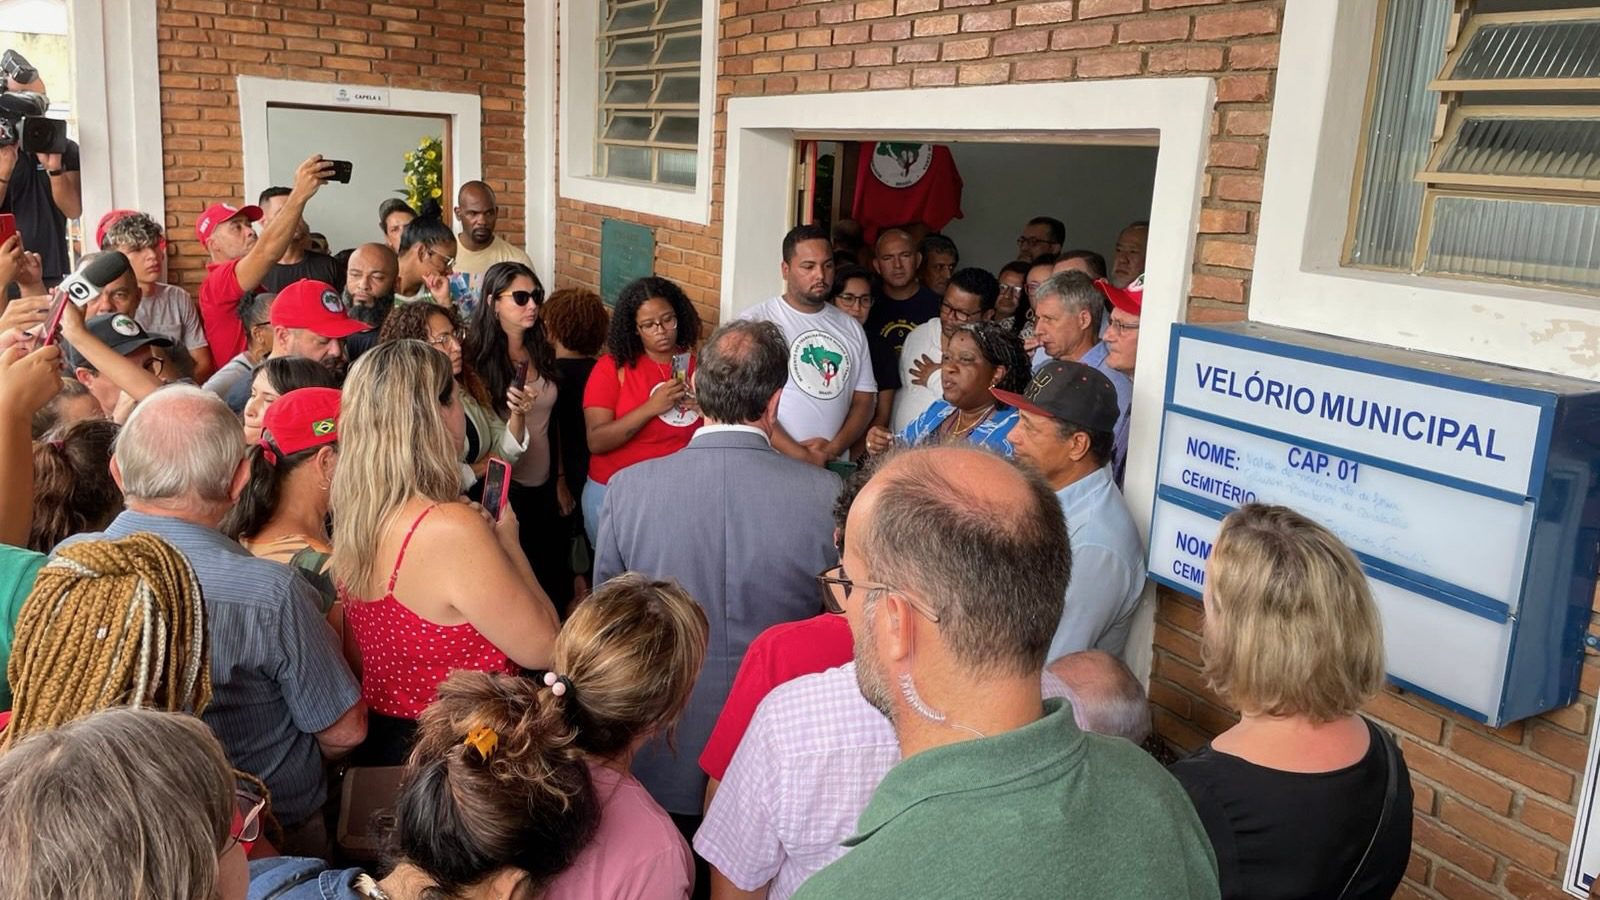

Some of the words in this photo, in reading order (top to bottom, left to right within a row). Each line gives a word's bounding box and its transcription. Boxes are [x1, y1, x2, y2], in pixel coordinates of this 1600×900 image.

[1196, 363, 1315, 415] VELÓRIO
[1319, 391, 1506, 462] MUNICIPAL
[1186, 436, 1241, 471] NOME:
[1288, 447, 1331, 477] CAP.
[1338, 460, 1360, 484] 01
[1181, 469, 1259, 504] CEMITÉRIO
[1176, 531, 1213, 560] NOM
